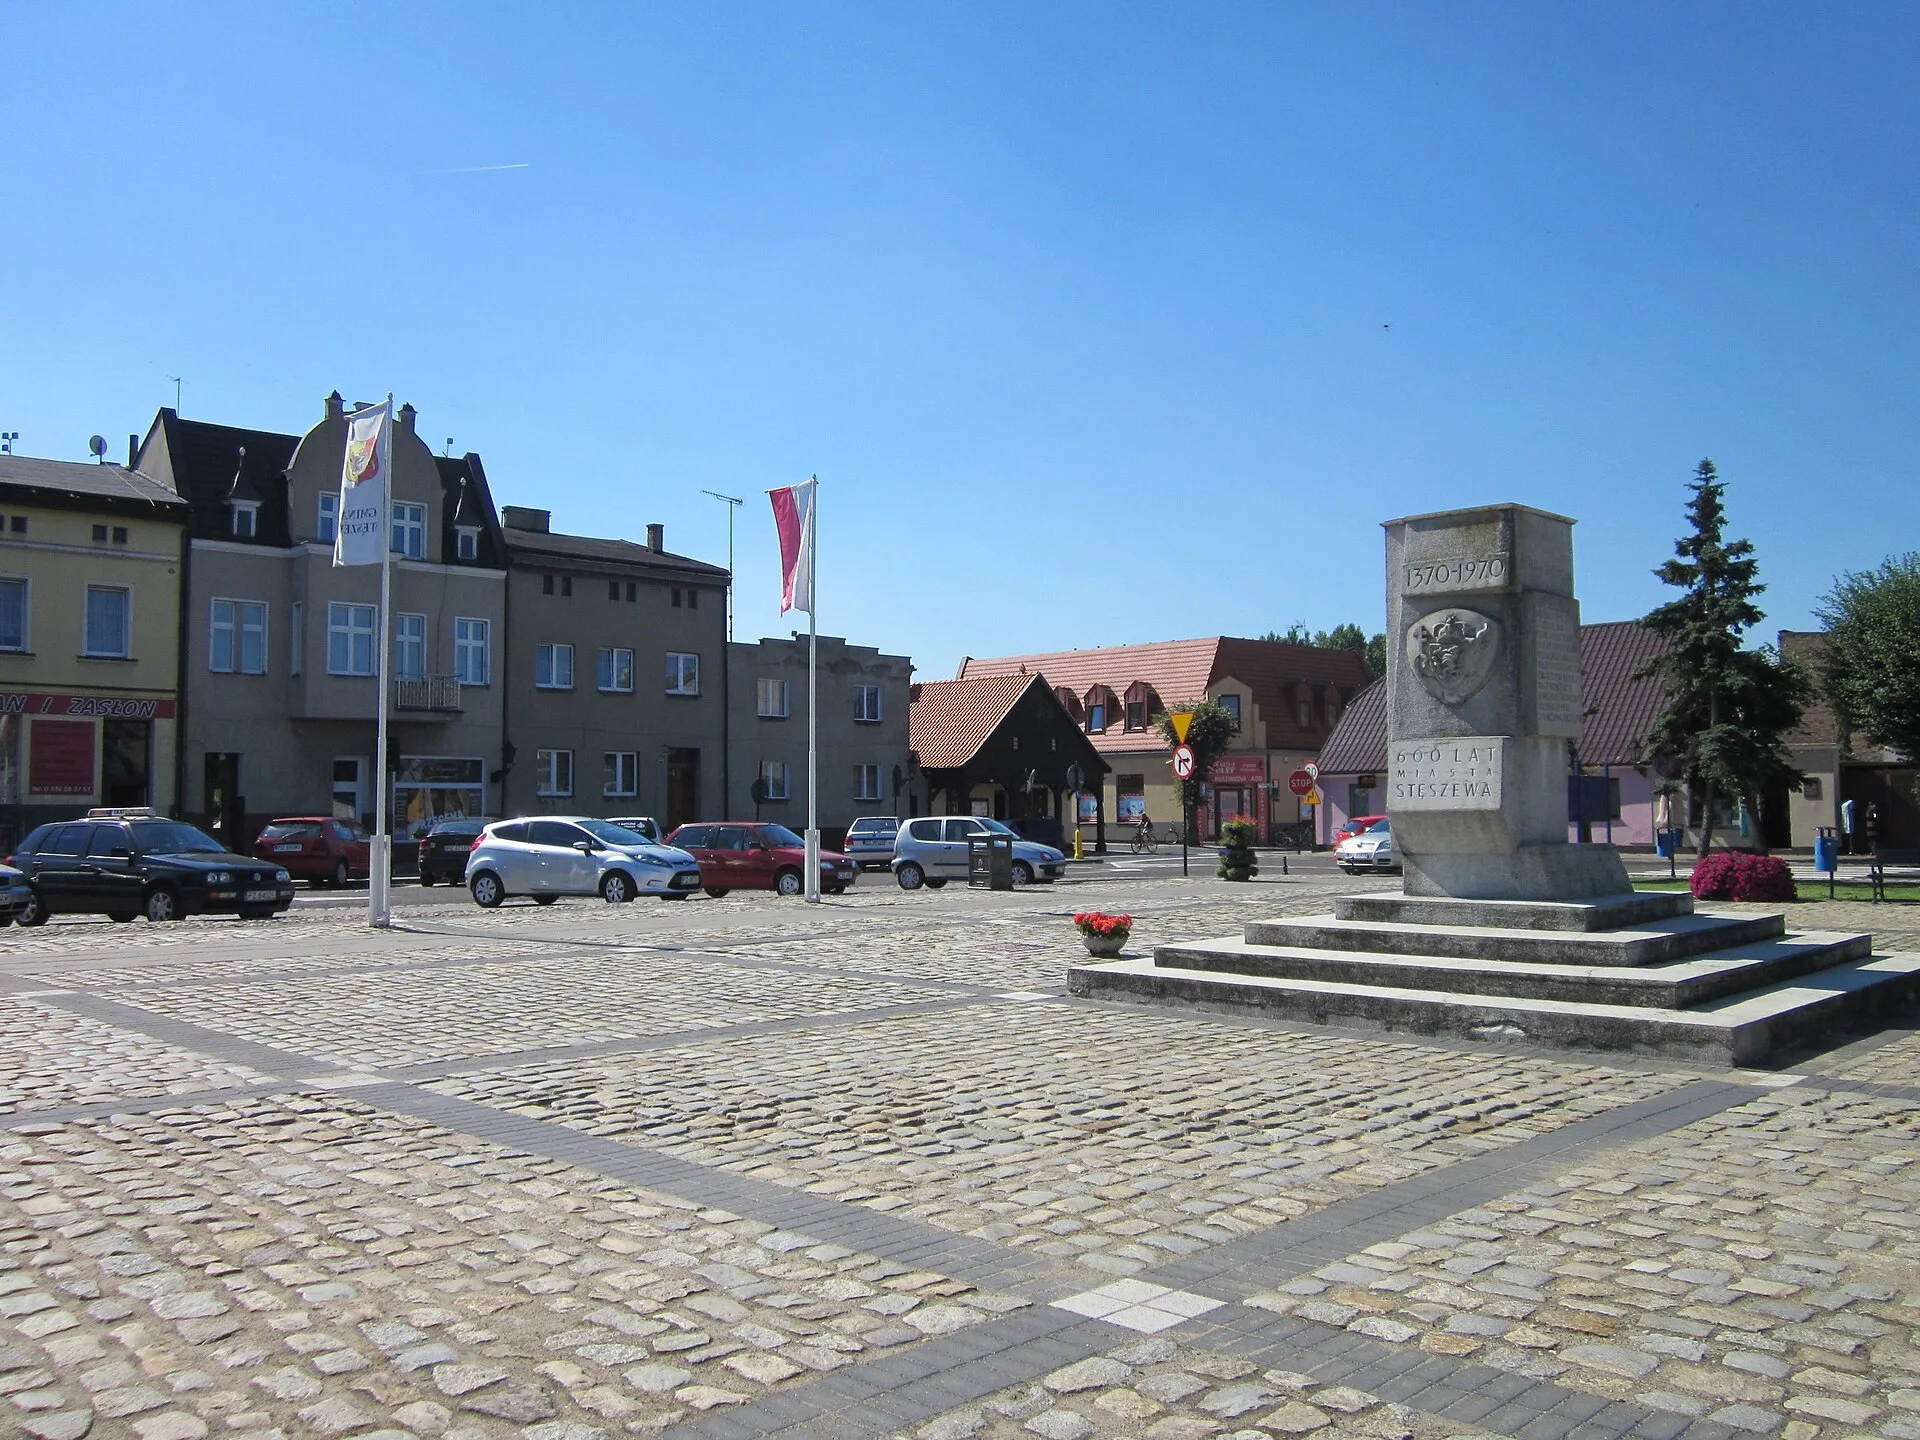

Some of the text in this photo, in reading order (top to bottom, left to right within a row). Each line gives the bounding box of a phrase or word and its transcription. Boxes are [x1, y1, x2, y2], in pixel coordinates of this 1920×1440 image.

[1407, 558, 1505, 588] 1370-1970
[41, 697, 54, 713] I
[67, 697, 157, 717] ZASŁON
[1397, 747, 1496, 764] 600 LAT
[1397, 768, 1493, 778] MIASTA
[1291, 779, 1312, 788] STOP
[1396, 783, 1493, 799] STĘSZEWA
